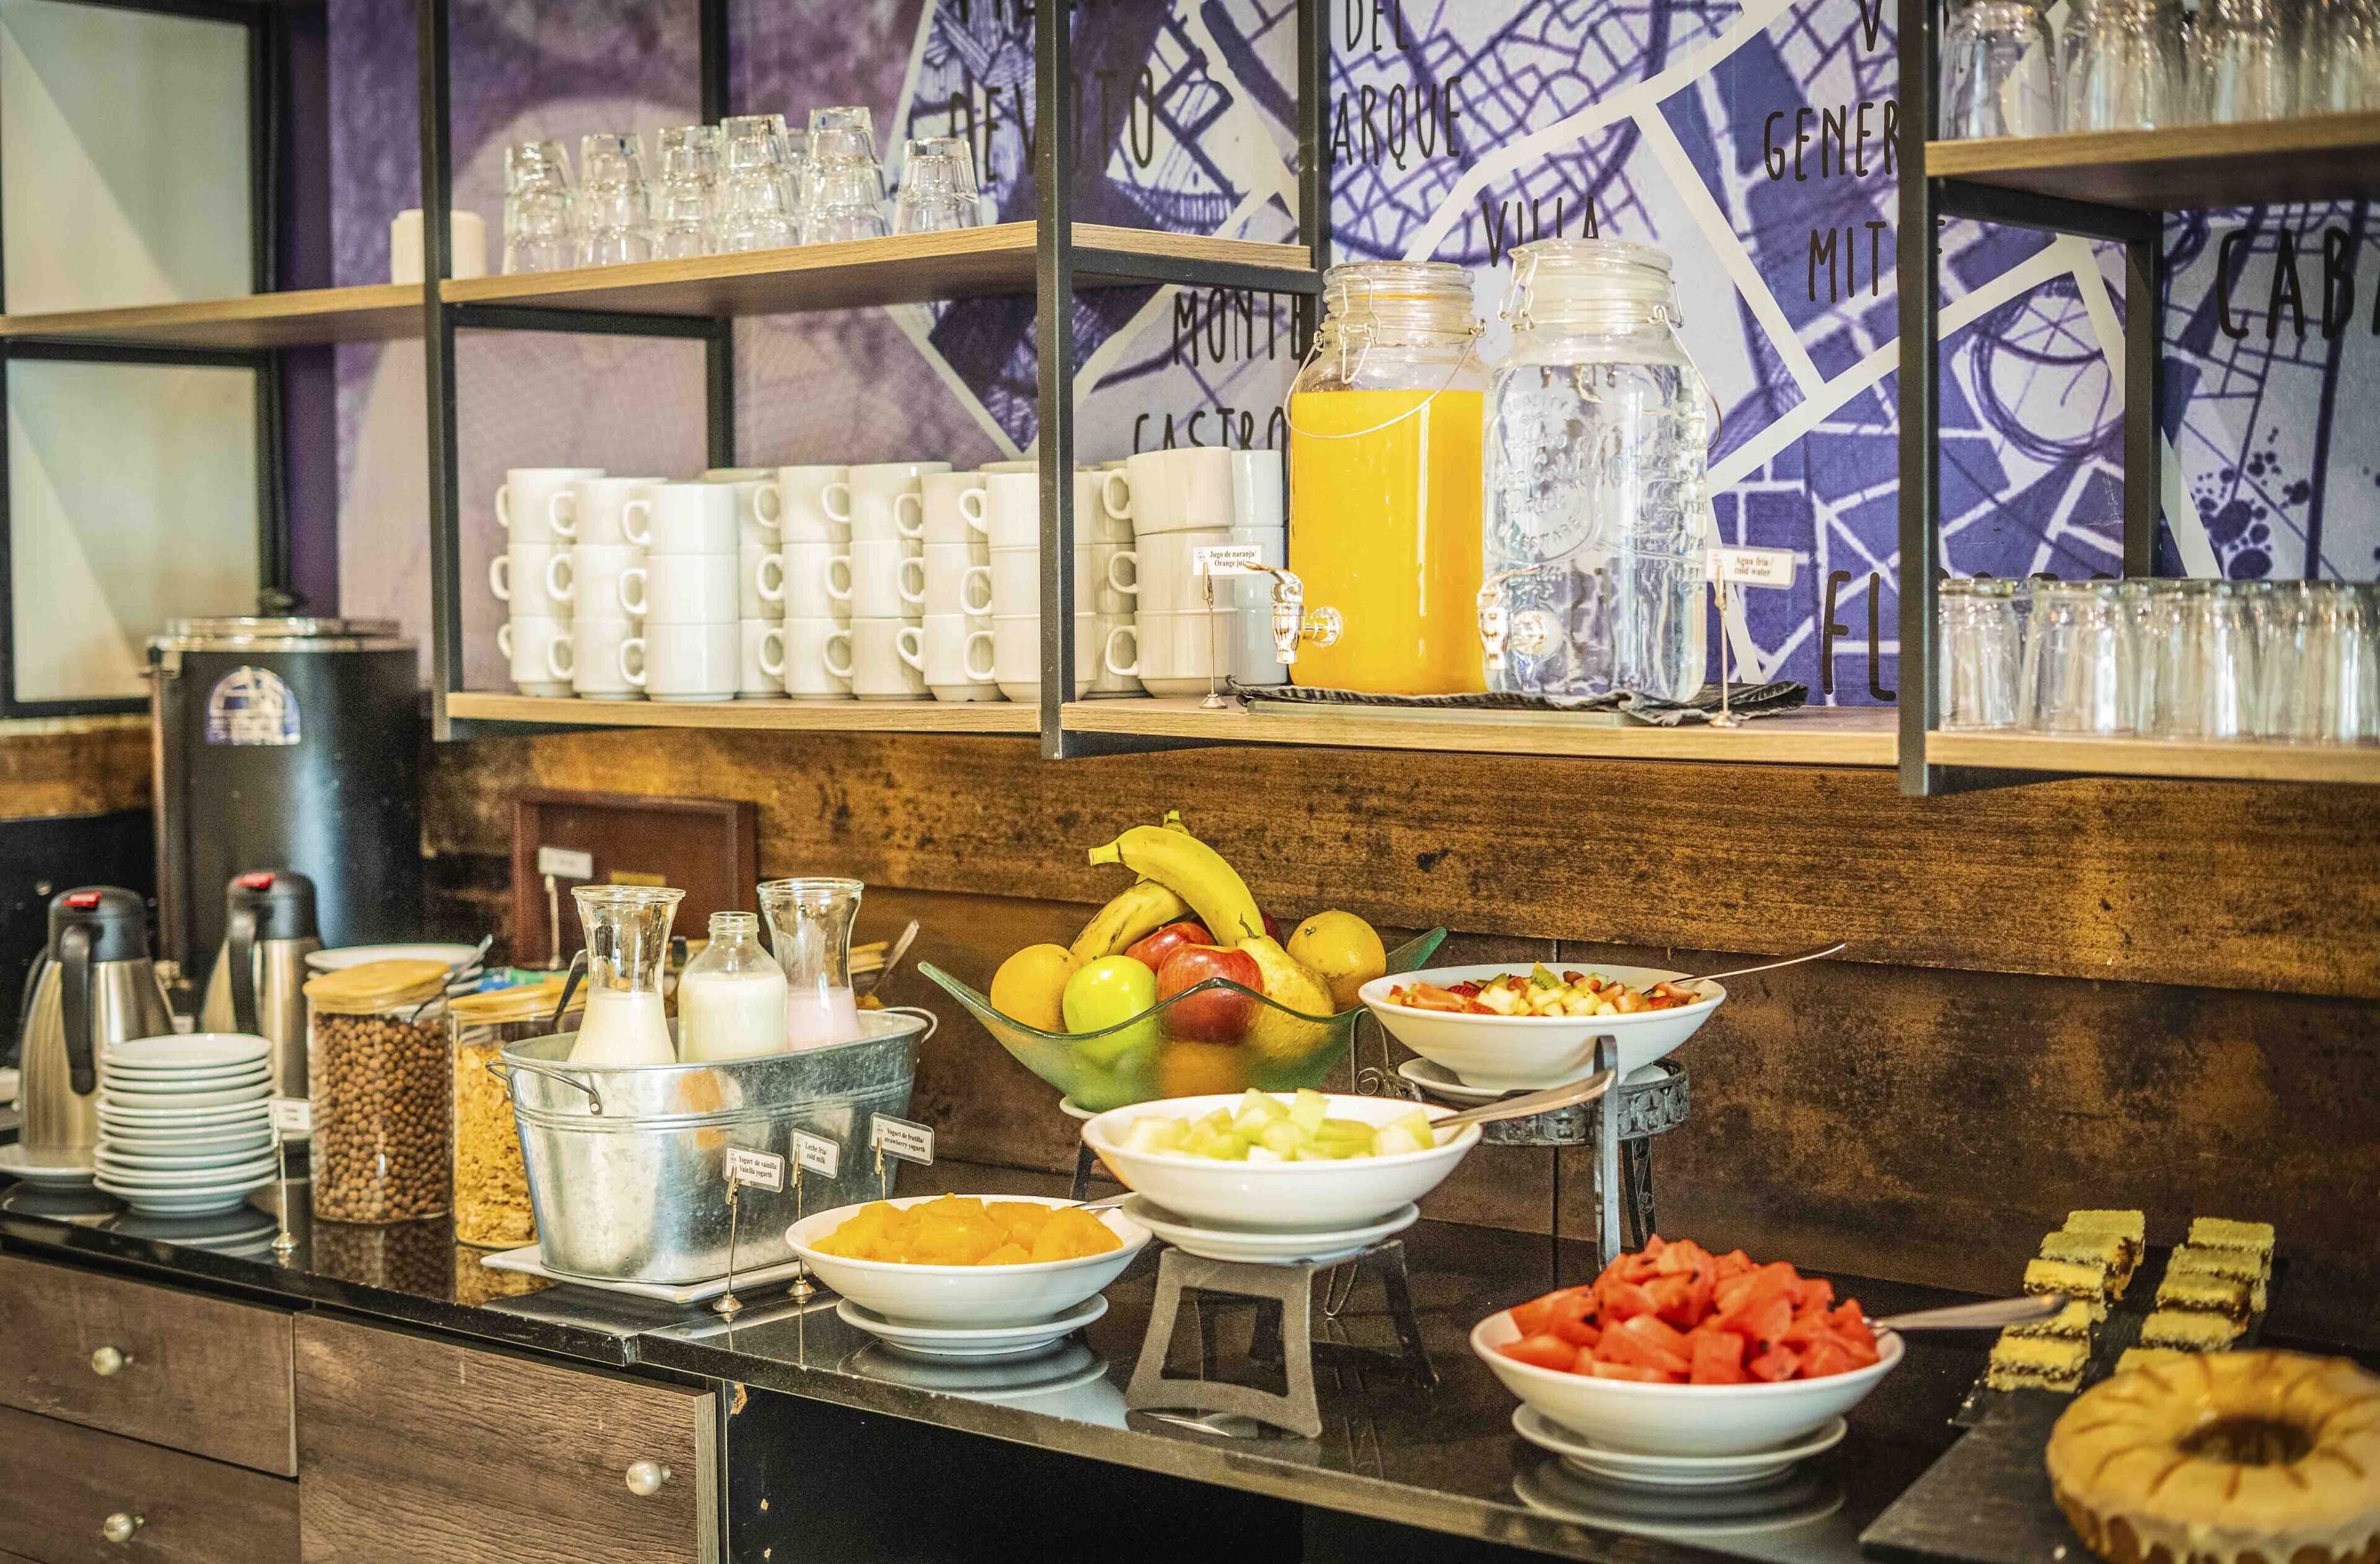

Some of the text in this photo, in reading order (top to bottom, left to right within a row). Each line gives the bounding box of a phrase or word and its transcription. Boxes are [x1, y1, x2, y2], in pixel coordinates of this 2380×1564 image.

[1331, 76, 1462, 171] ARQUE
[1764, 100, 1899, 182] GENER
[2216, 226, 2380, 340] CAB
[1210, 551, 1223, 559] Jugo
[1737, 556, 1753, 566] Agua
[1735, 566, 1771, 576] cold water
[887, 1128, 901, 1136] Yogurt
[805, 1141, 818, 1152] Leche
[884, 1137, 925, 1152] strawberry yogurth
[739, 1156, 753, 1164] Yogurt
[816, 1156, 826, 1164] milk
[756, 1170, 773, 1179] yogurth
